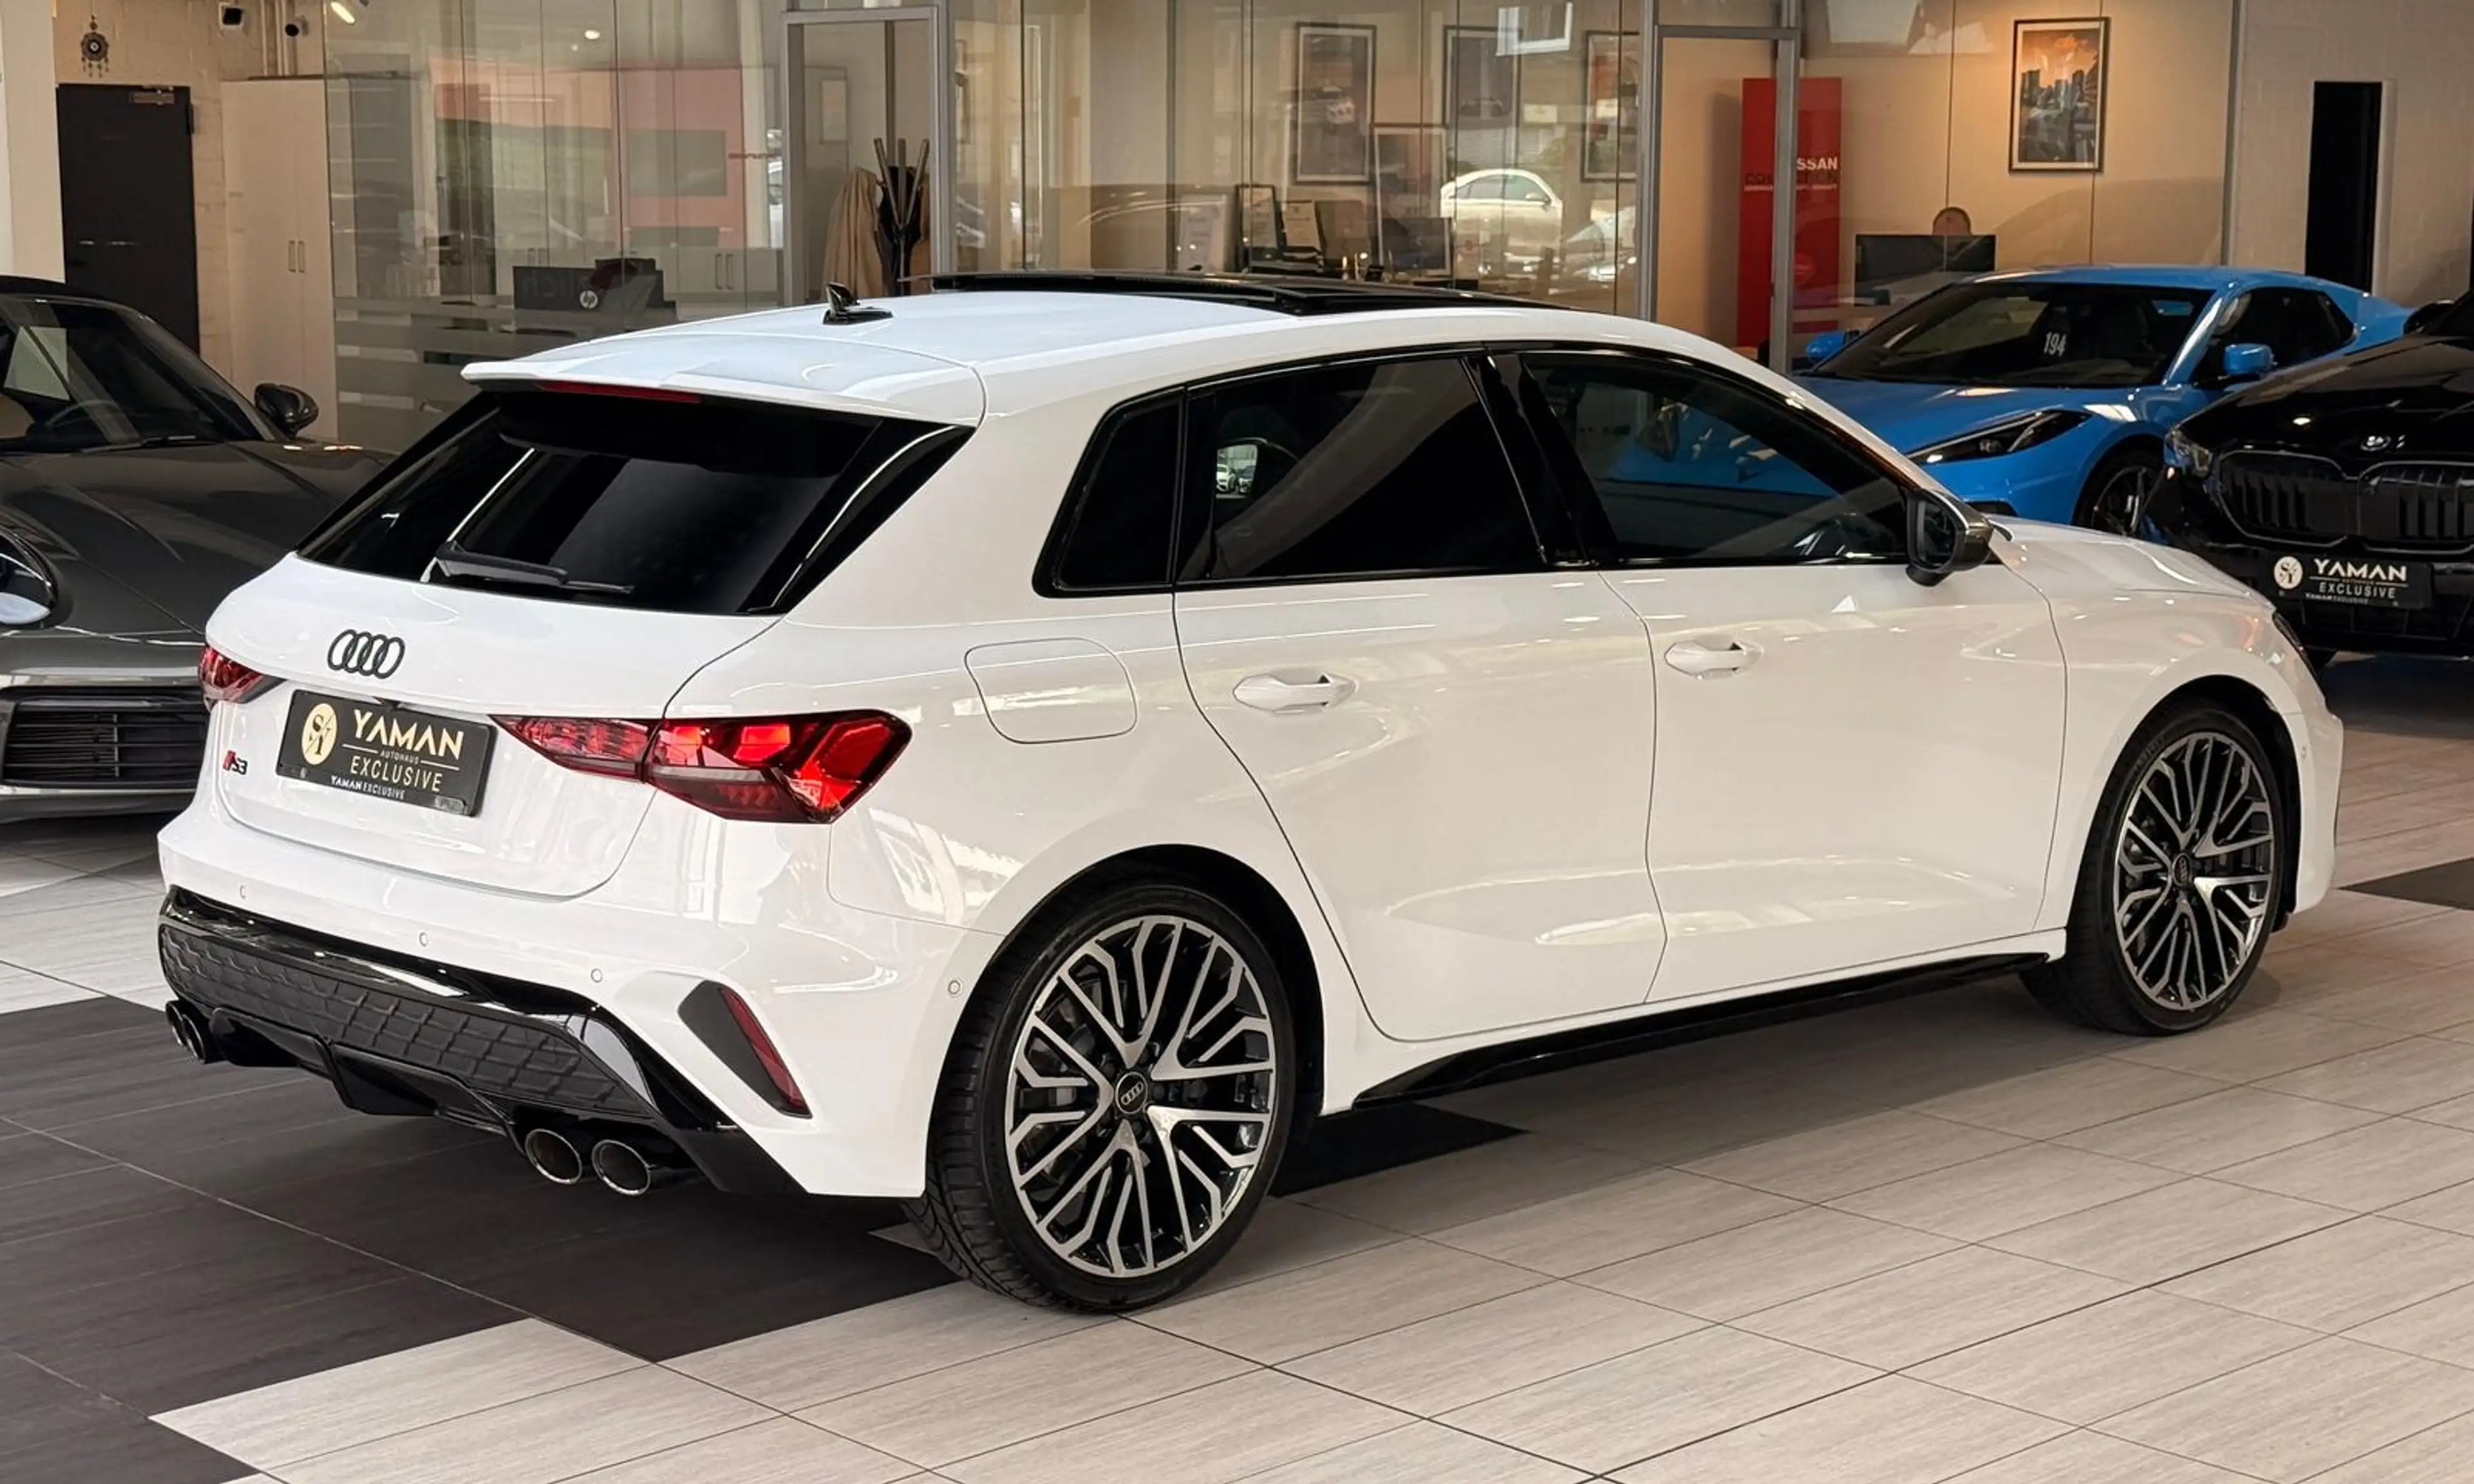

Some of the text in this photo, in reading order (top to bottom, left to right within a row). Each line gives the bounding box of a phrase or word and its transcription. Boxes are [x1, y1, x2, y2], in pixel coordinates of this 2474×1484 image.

[1796, 157, 1837, 171] SSAN
[2044, 332, 2066, 356] 194
[2314, 558, 2407, 582] YAMAN
[2319, 581, 2396, 599] EXCLUSIVE
[354, 709, 464, 759] YAMAN
[350, 756, 443, 792] EXCLUSIVE
